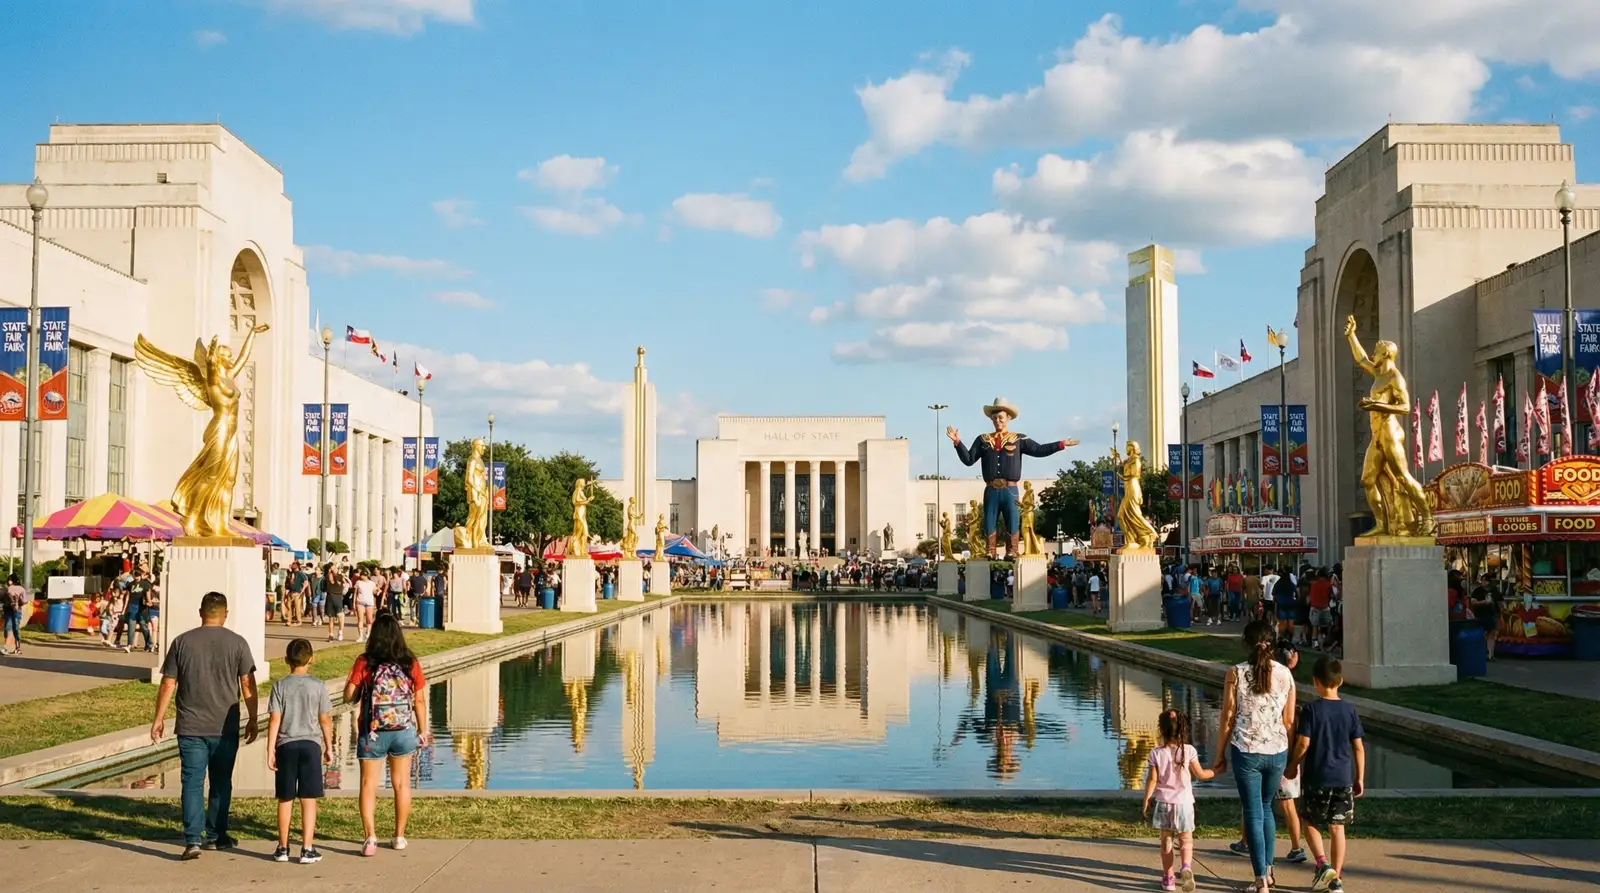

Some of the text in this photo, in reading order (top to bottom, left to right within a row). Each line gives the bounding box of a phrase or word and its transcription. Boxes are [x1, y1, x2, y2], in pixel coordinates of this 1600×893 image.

[2, 322, 26, 332] STATE
[43, 321, 67, 331] STATE
[1537, 323, 1560, 333] STATE
[1578, 323, 1600, 333] STATE
[5, 332, 22, 342] FAIR
[45, 331, 62, 341] FAIR
[1541, 333, 1558, 344] FAIR
[1581, 333, 1598, 343] FAIR
[764, 432, 841, 441] HALL OF STATE
[1554, 468, 1600, 482] FOOD
[1495, 480, 1520, 500] FOOD
[1555, 518, 1596, 529] FOOD
